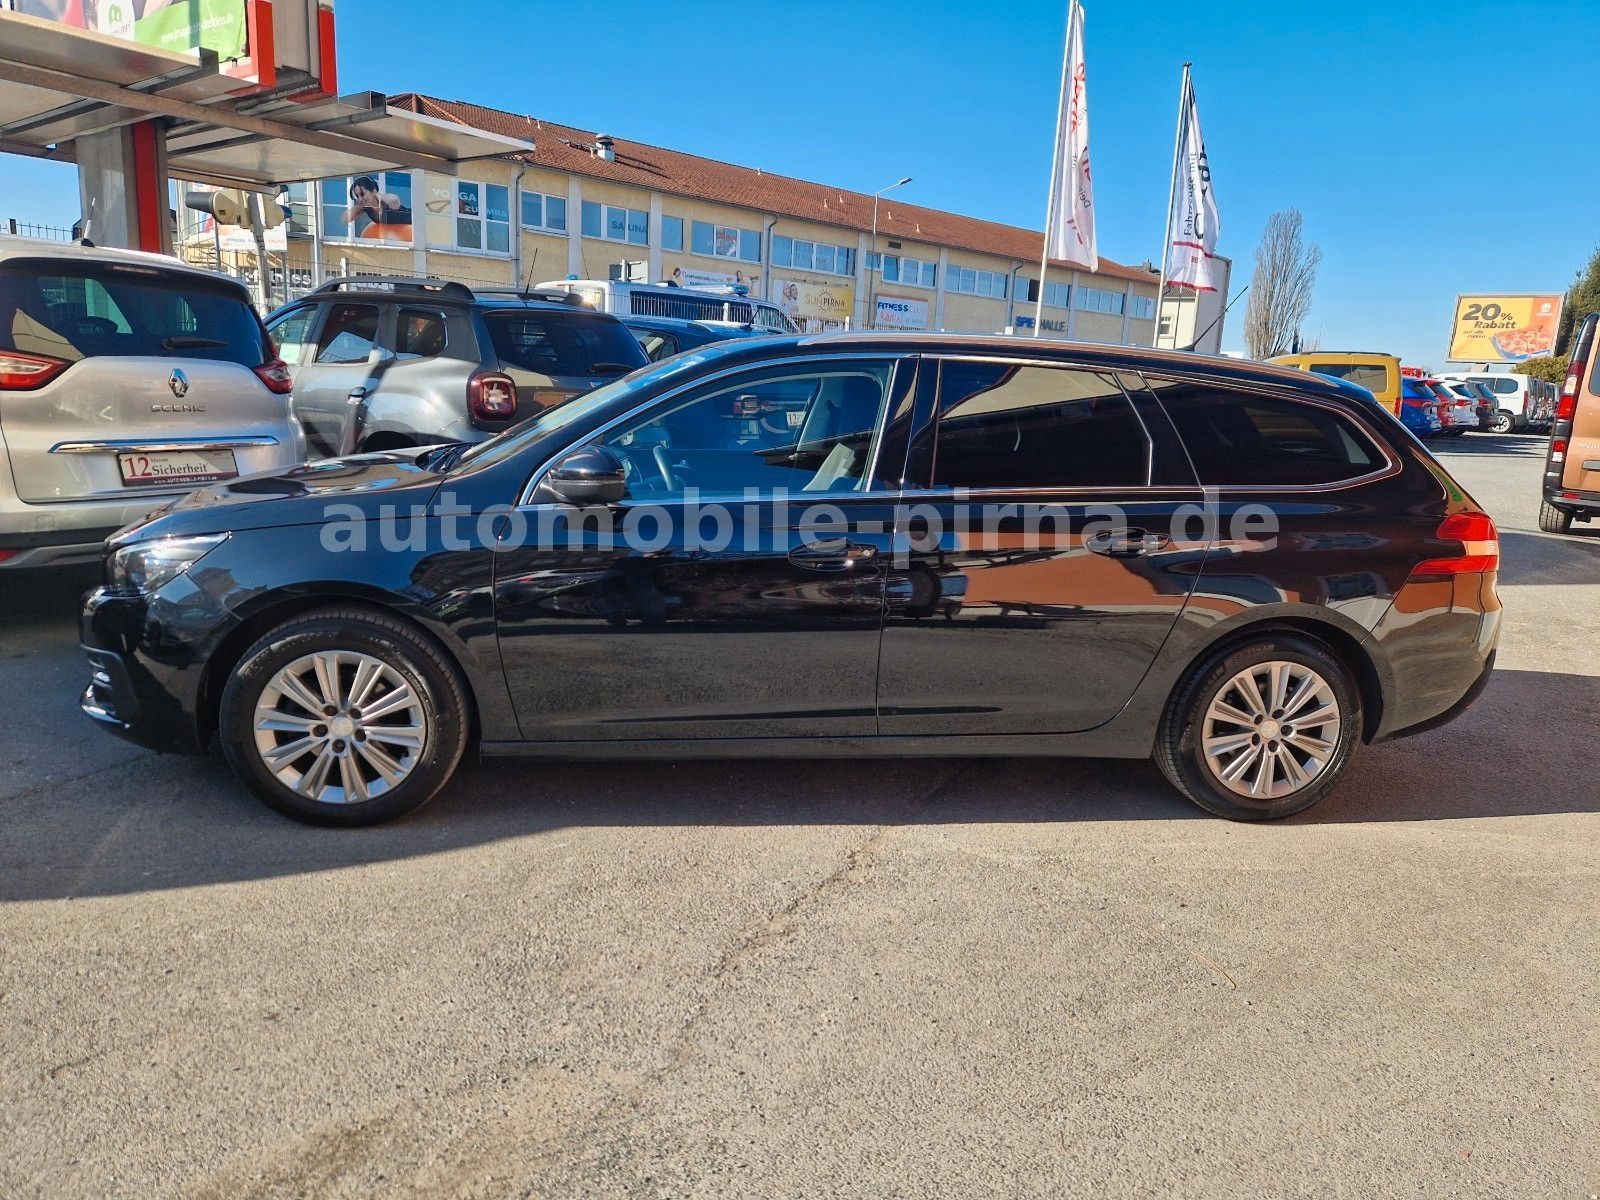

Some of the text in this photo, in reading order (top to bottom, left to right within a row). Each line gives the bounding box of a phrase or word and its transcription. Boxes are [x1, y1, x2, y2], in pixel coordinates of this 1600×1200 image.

[464, 204, 507, 217] ZUMBA
[611, 220, 647, 233] SAUNA
[1015, 315, 1067, 332] SPIEHALLE
[1474, 321, 1518, 329] Rabatt
[151, 404, 206, 412] SCENIC
[124, 456, 152, 477] 12
[151, 463, 207, 475] Sicherheit
